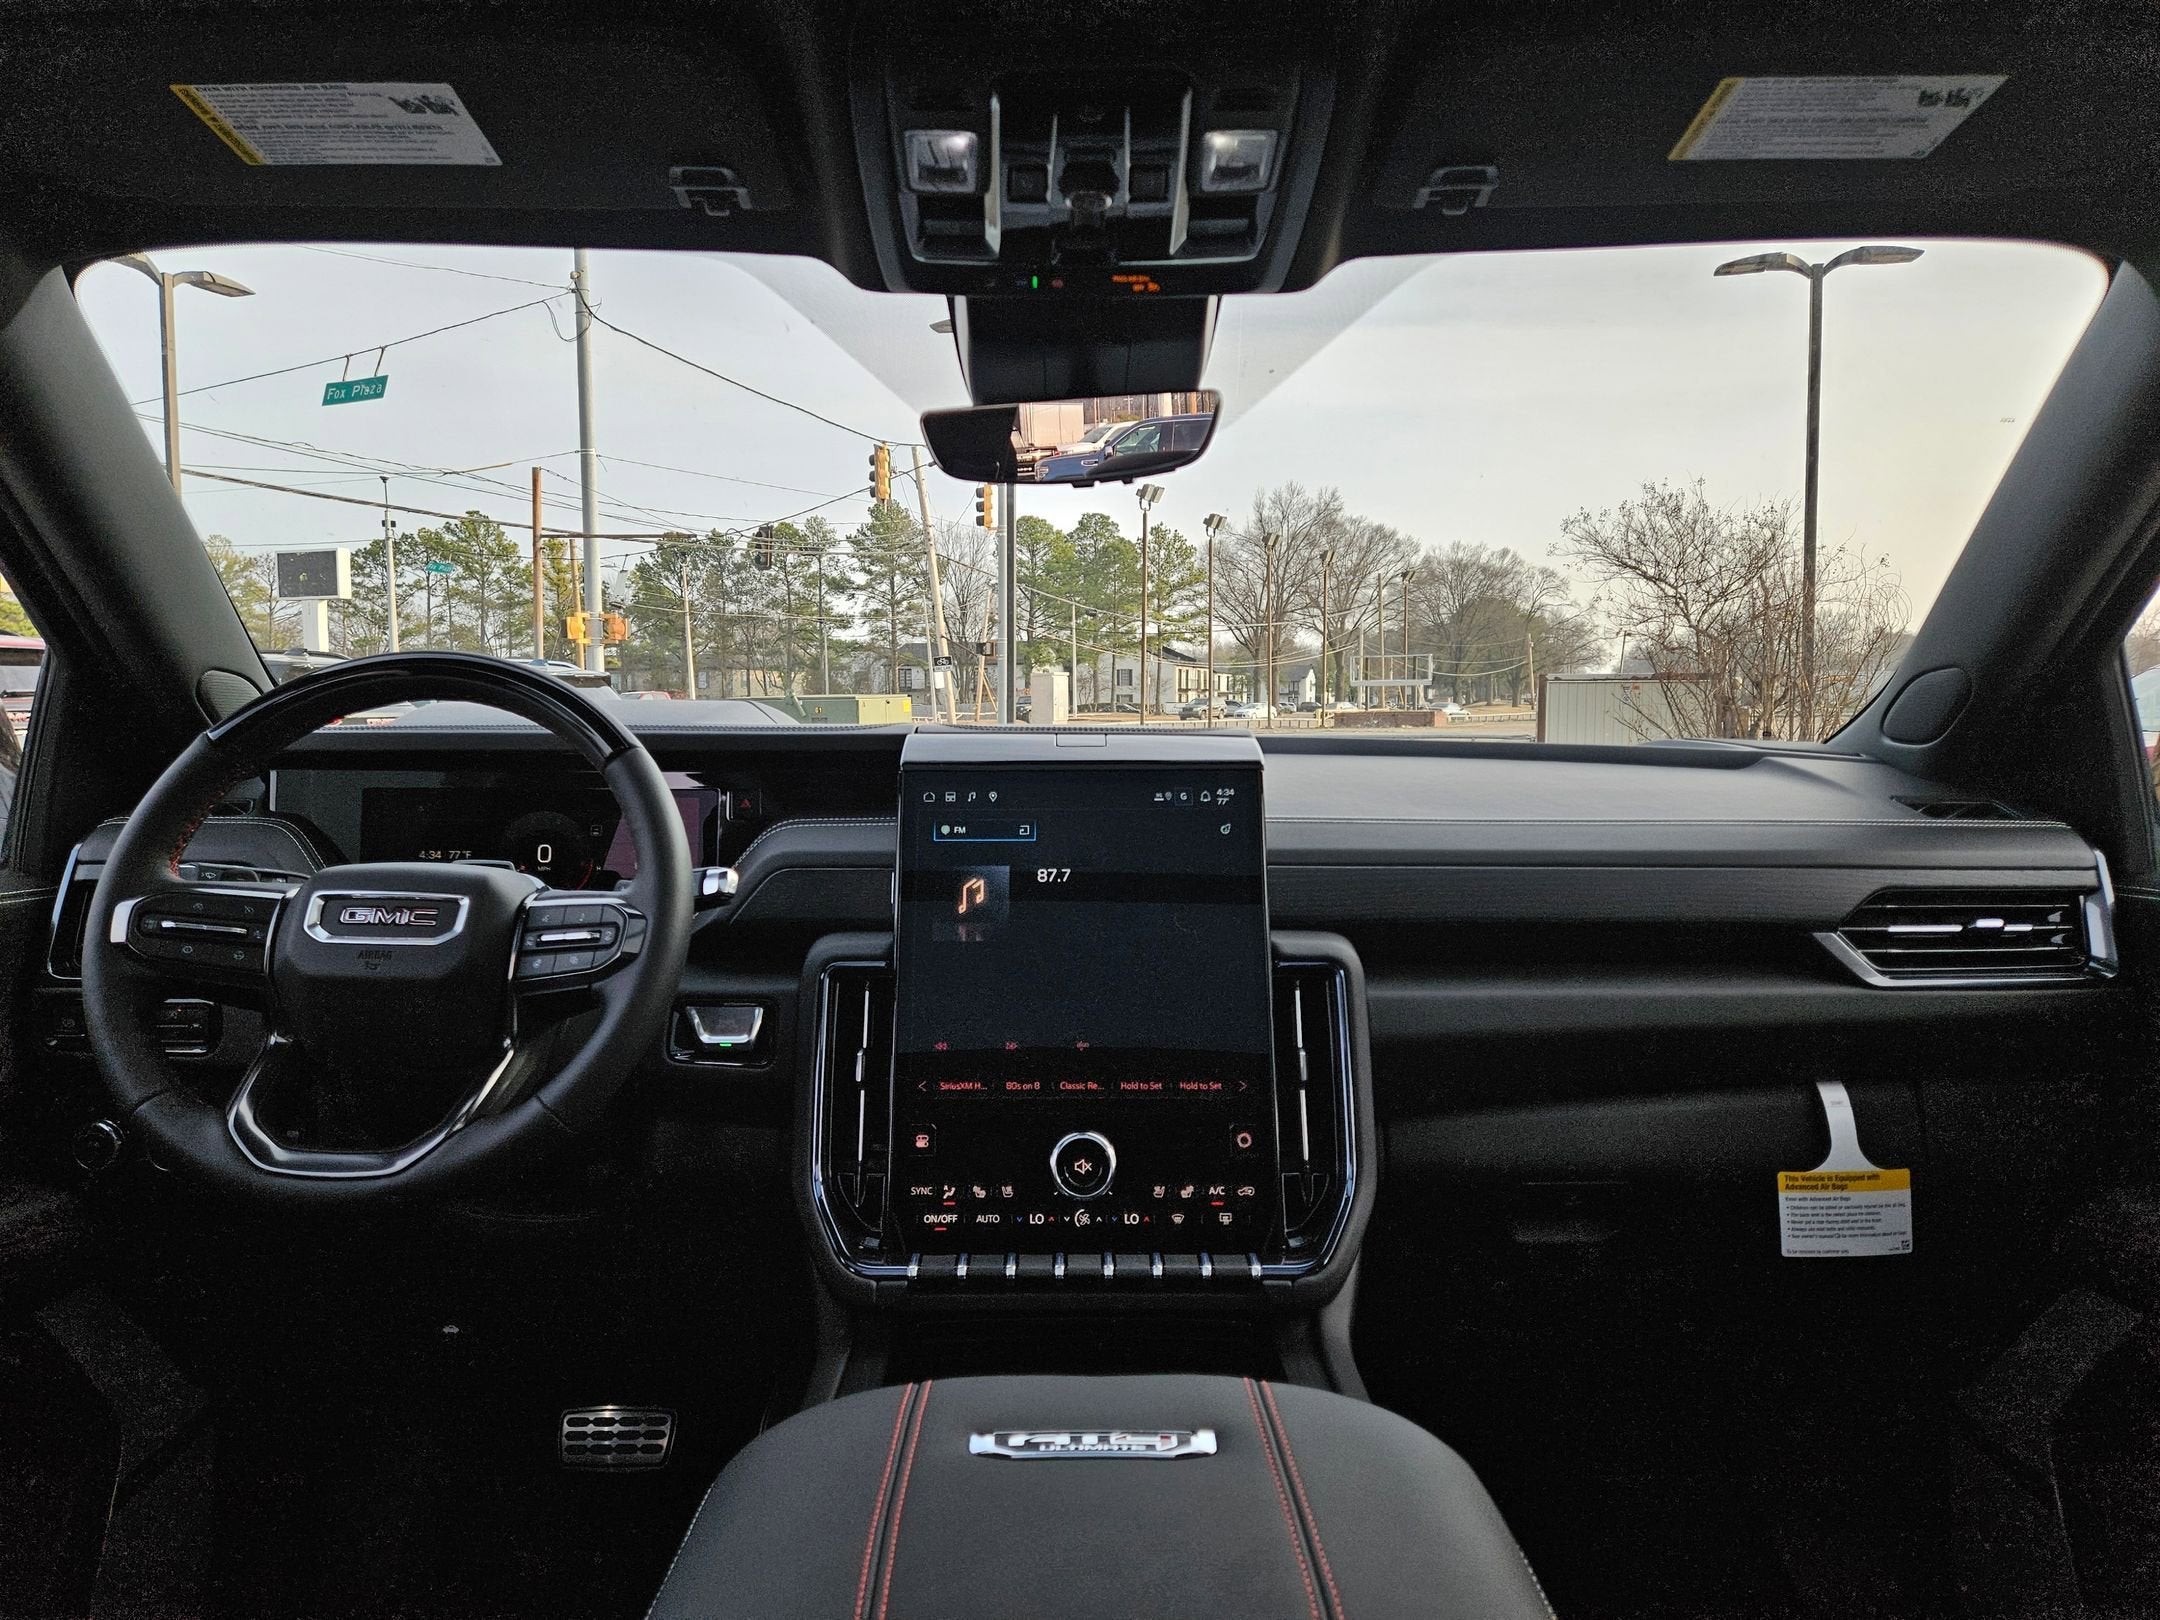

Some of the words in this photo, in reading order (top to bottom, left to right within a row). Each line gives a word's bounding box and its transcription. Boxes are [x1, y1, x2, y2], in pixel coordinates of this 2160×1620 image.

[327, 388, 346, 400] Fox
[352, 384, 382, 397] Plaza
[953, 826, 966, 834] FM
[418, 850, 442, 859] 4:34
[537, 844, 552, 863] 0
[1037, 868, 1071, 883] 87.7
[340, 907, 439, 926] GMC
[357, 950, 393, 960] AIRBAG
[940, 1081, 973, 1090] SiriusXM
[1022, 1081, 1033, 1090] on
[1059, 1081, 1086, 1090] Classic
[1120, 1081, 1139, 1090] Hold
[1140, 1081, 1148, 1090] to
[1149, 1081, 1163, 1090] Set
[1179, 1081, 1198, 1090] Hold
[1199, 1081, 1208, 1090] to
[1209, 1081, 1222, 1090] Set
[1209, 1186, 1226, 1195] A/C
[1831, 1182, 1848, 1191] Bags
[910, 1187, 933, 1196] SYNC
[923, 1214, 958, 1224] ON/OFF
[976, 1214, 1000, 1224] AUTO
[1029, 1213, 1045, 1225] LO
[1124, 1213, 1139, 1225] LO
[1039, 1443, 1147, 1452] ULTIMATE
